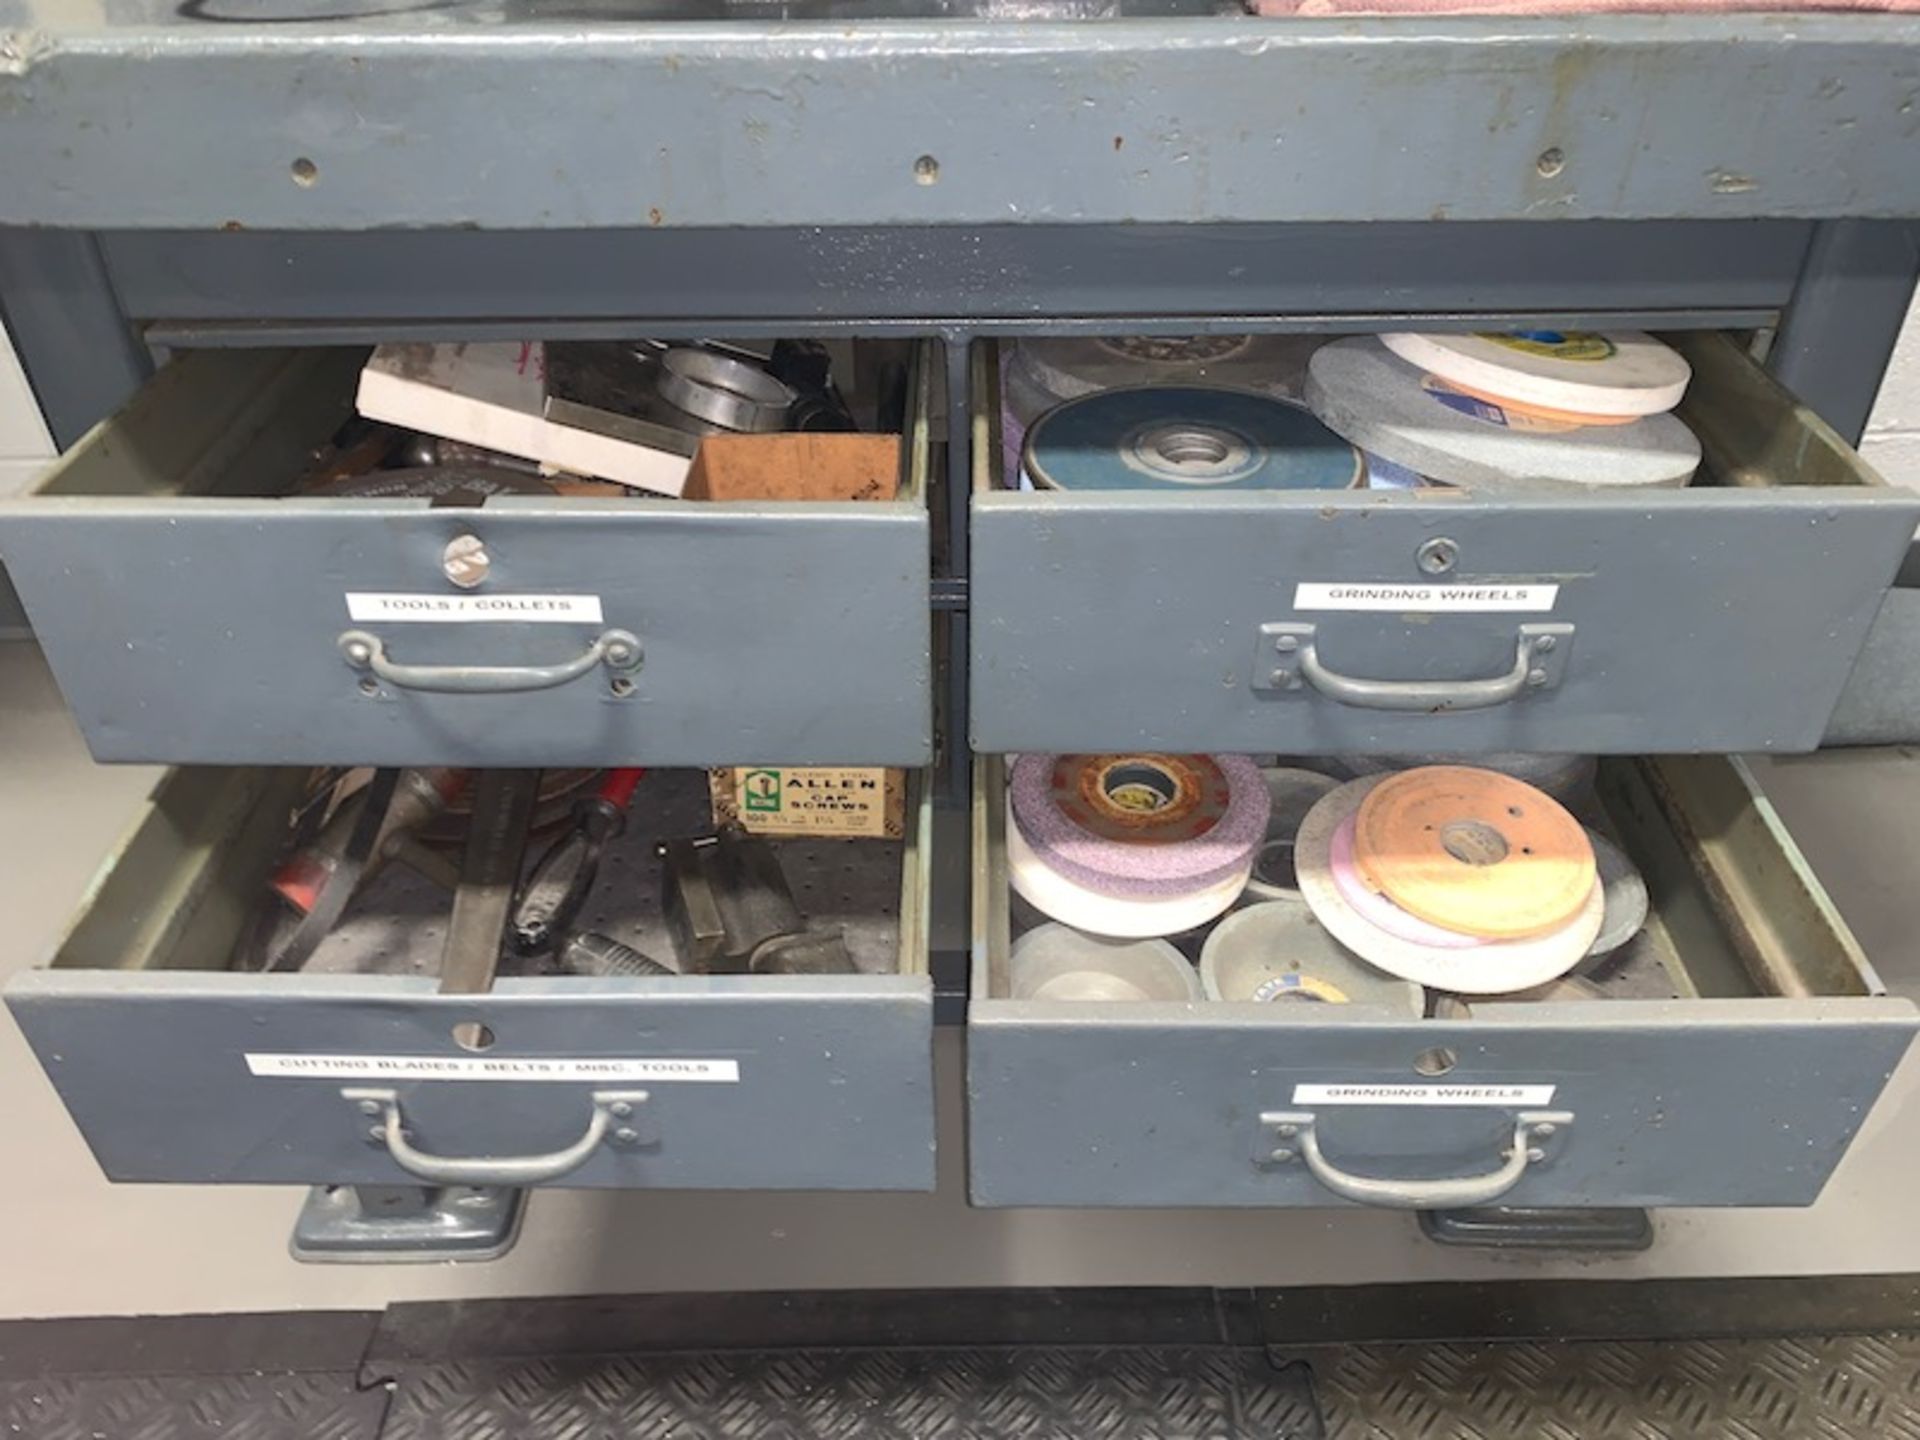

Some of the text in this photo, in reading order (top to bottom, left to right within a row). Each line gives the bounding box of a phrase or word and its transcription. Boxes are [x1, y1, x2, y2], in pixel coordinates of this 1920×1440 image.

[1328, 588, 1529, 601] GRINDING WHEELS
[380, 599, 450, 611] TOOLS
[474, 599, 573, 611] COLLETS
[786, 778, 876, 790] ALLEN
[811, 794, 849, 802] CAP
[790, 801, 870, 811] SCREWS
[279, 1058, 370, 1070] CUTTING
[377, 1060, 460, 1071] BLADES
[483, 1062, 552, 1072] BELTS
[575, 1062, 632, 1073] MISC.
[639, 1062, 711, 1073] TOOLS
[1326, 1088, 1525, 1098] GRINDING WHEELS
